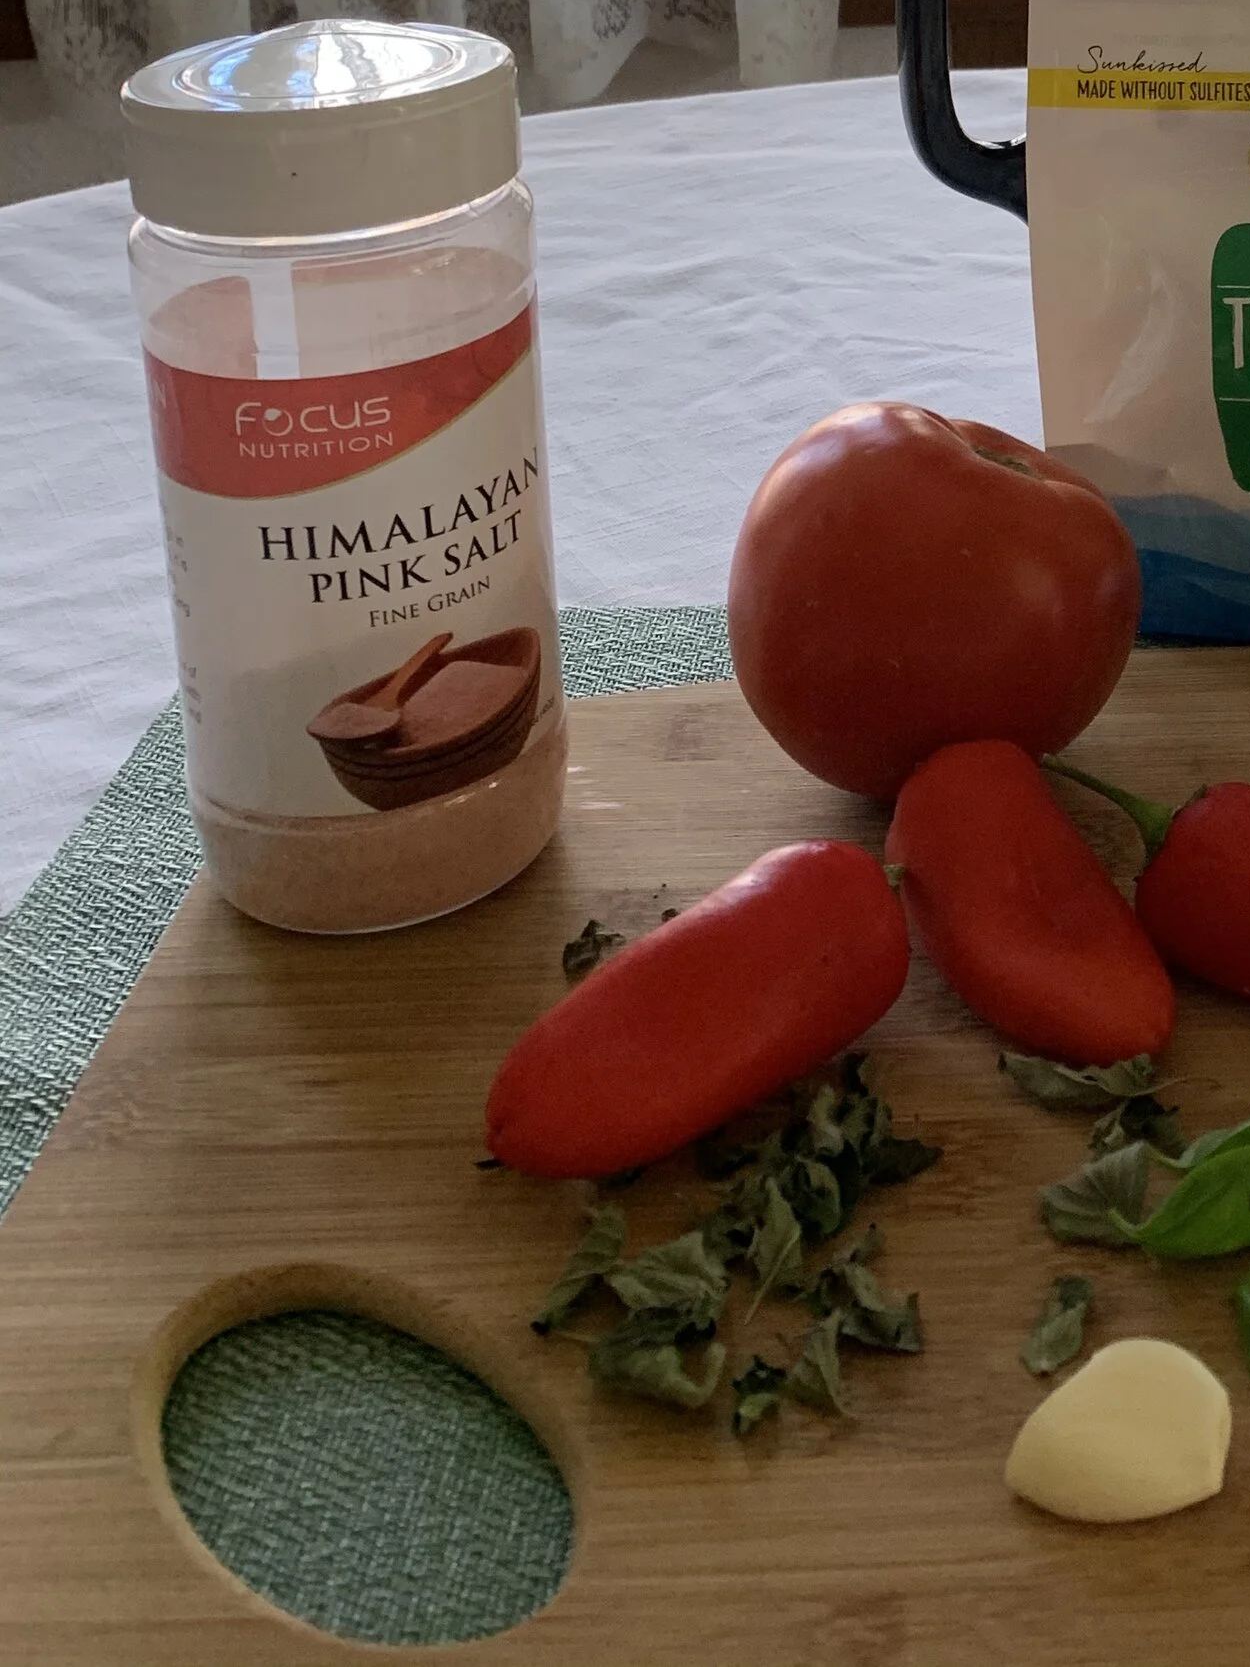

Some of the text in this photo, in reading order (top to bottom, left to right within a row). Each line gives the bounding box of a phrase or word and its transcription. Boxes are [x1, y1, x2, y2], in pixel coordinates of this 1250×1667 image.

[1077, 45, 1207, 73] Sunkissed
[1077, 80, 1116, 99] MADE
[1121, 81, 1185, 100] WITHOUT
[236, 396, 391, 436] FOCUS
[239, 432, 393, 459] NUTRITION
[257, 445, 539, 561] HIMALAYAN
[308, 508, 522, 603] PINK SALT
